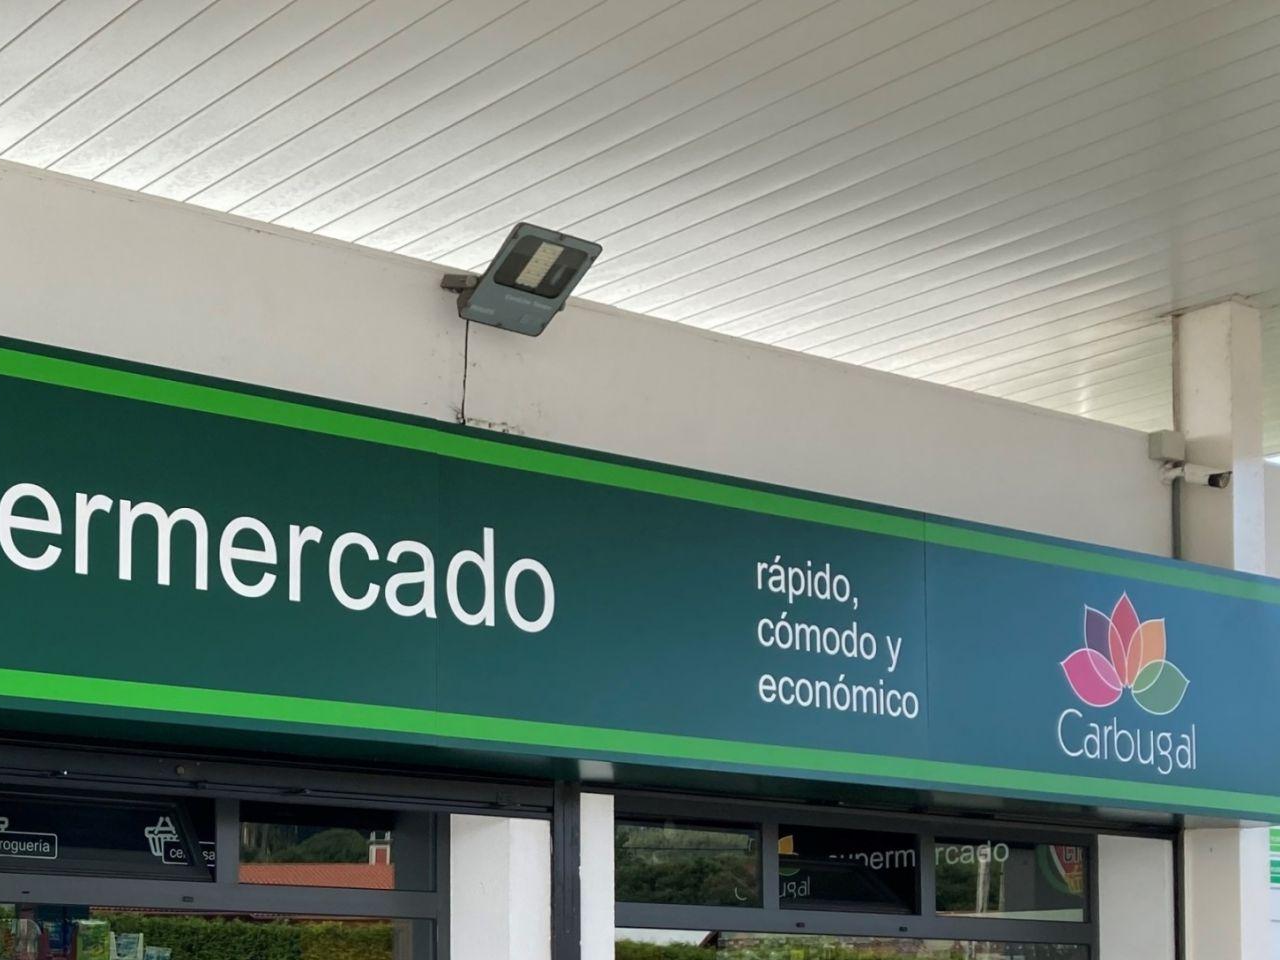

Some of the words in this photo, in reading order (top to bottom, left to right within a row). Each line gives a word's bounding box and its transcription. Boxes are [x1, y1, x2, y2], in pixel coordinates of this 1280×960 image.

[756, 555, 859, 610] rápido,
[757, 610, 877, 660] cómodo
[887, 635, 902, 672] y
[758, 673, 919, 720] económico
[1057, 708, 1198, 774] Carbugal
